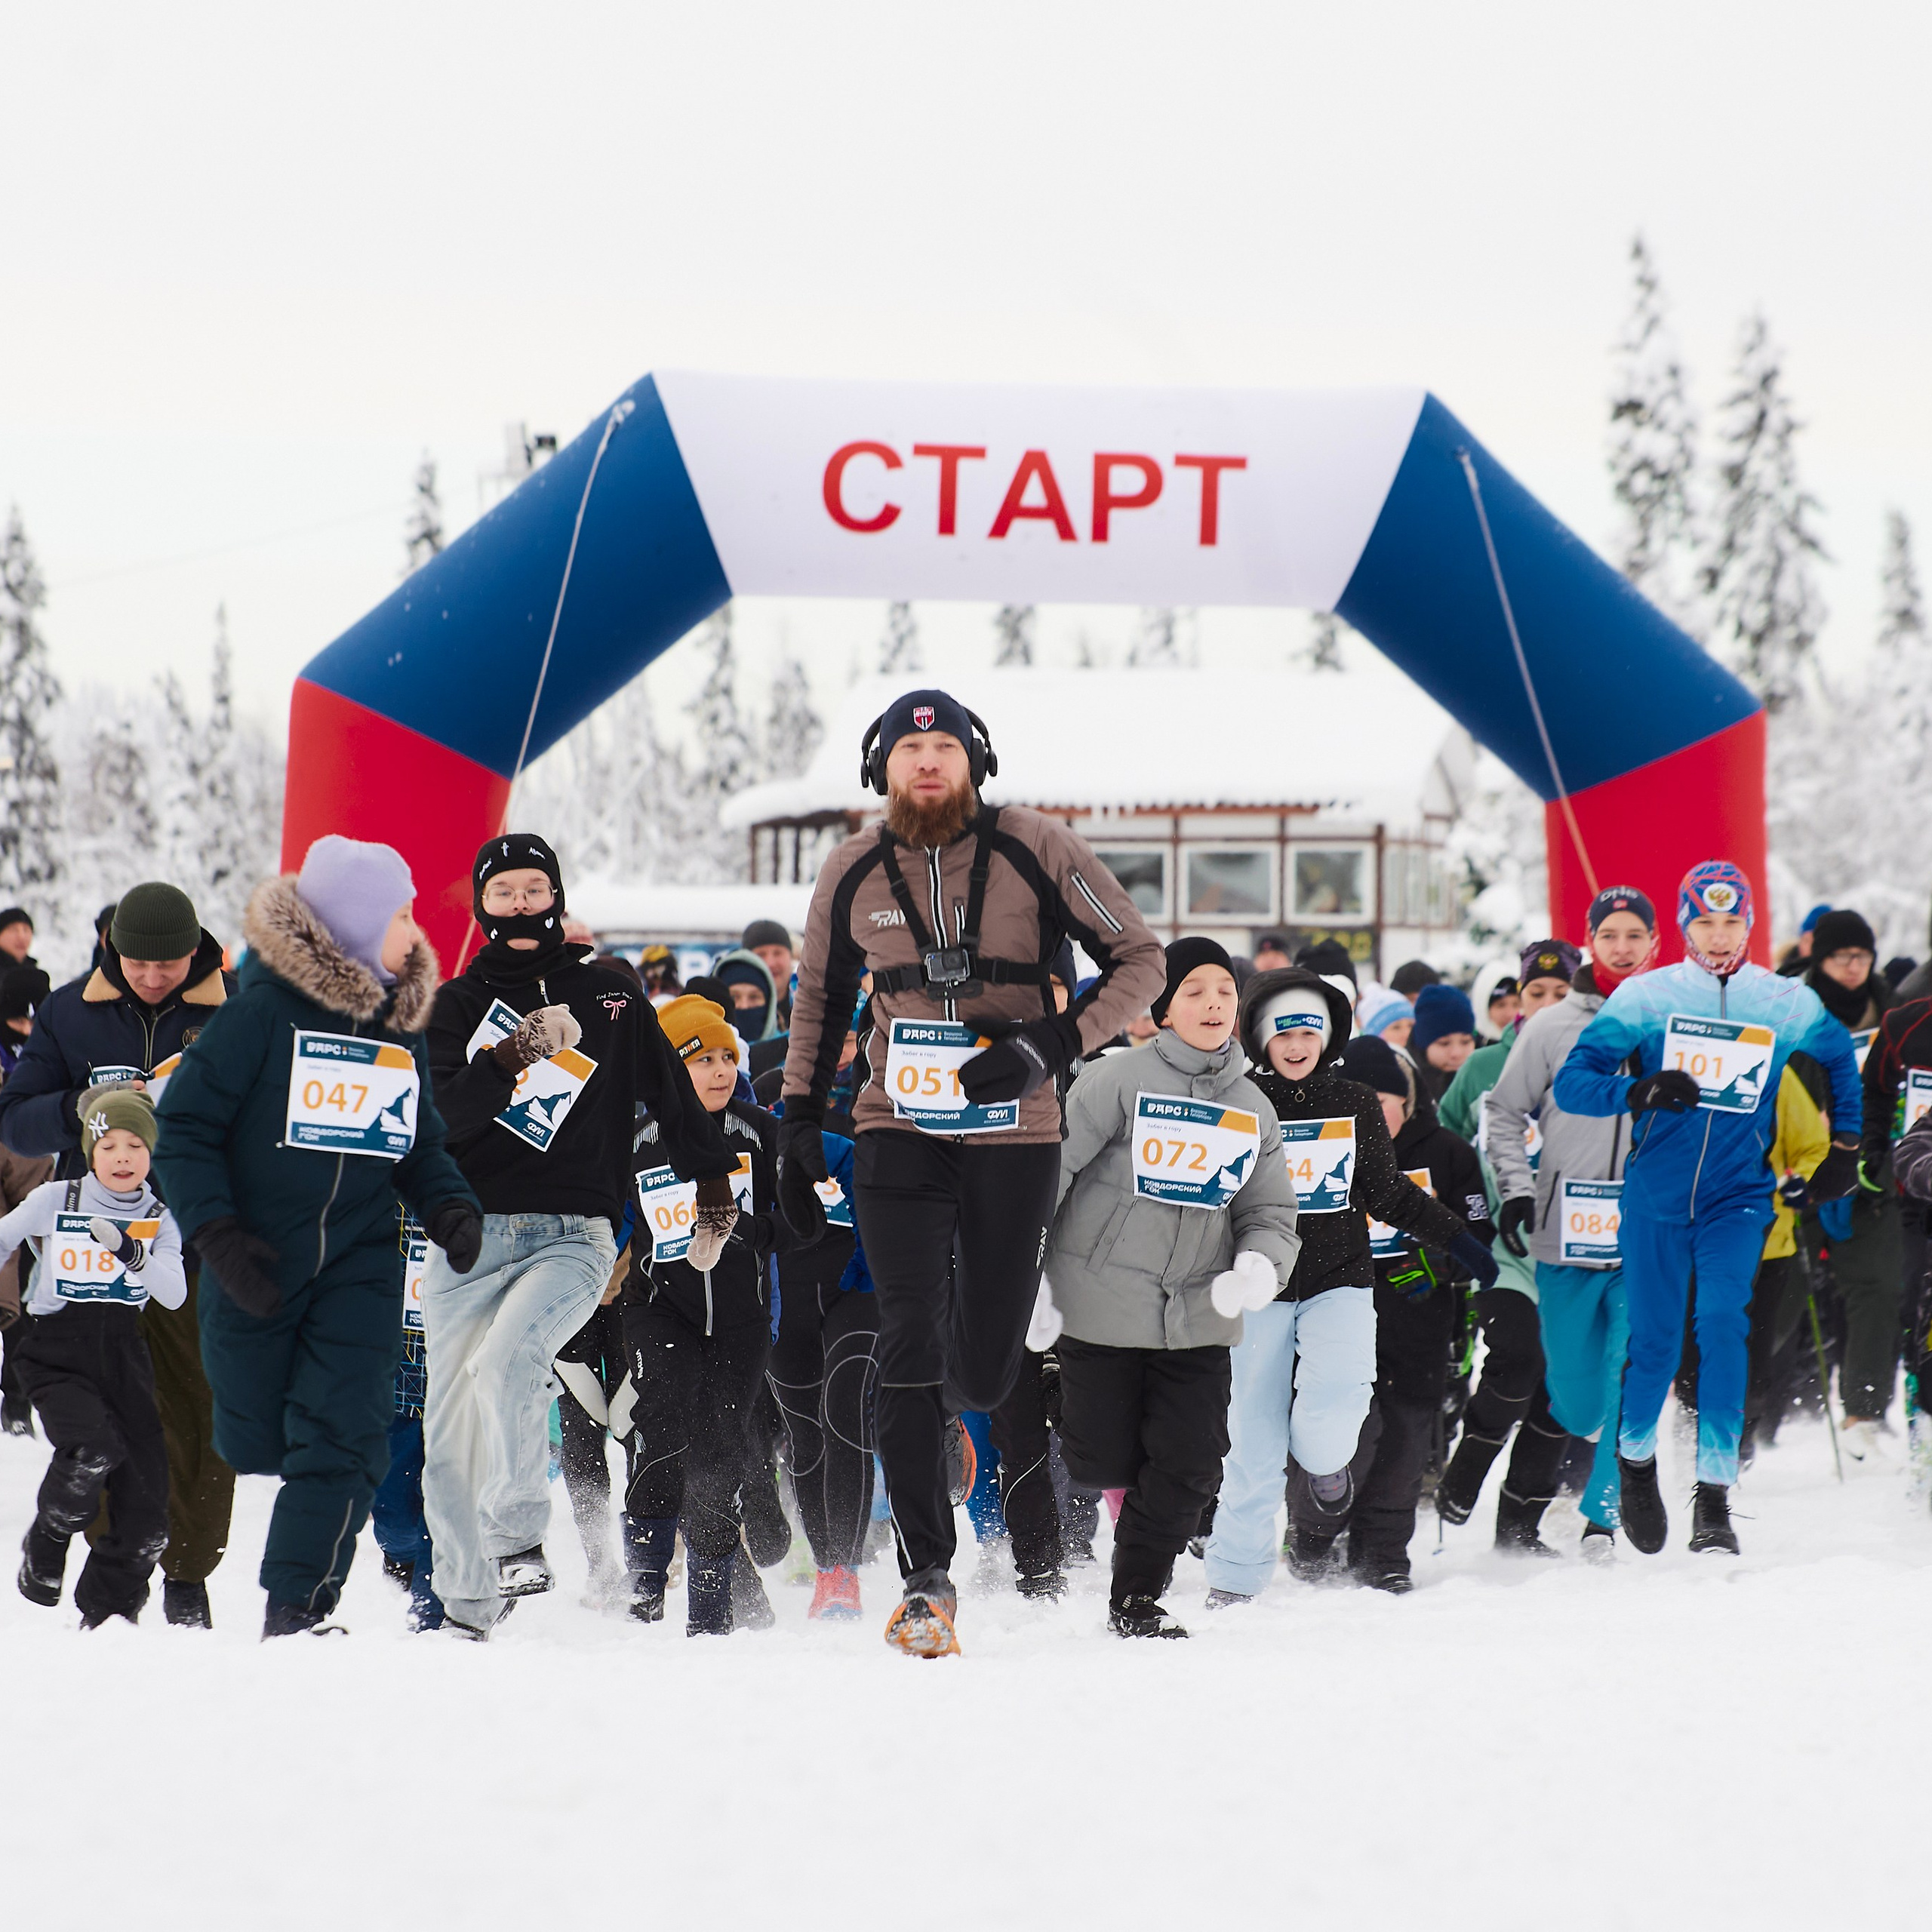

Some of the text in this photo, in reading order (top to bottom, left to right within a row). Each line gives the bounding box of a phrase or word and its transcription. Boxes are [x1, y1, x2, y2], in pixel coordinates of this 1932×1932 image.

[823, 440, 1247, 547] СТАРТ
[497, 1012, 518, 1031] ВАР
[678, 1038, 700, 1058] POWER
[1675, 1051, 1723, 1079] 101
[897, 1066, 960, 1097] 051
[303, 1080, 369, 1113] 047
[1143, 1137, 1208, 1171] 072
[1144, 1179, 1201, 1194] КОВДОРСКИЙ
[1571, 1213, 1619, 1235] 084
[663, 1238, 693, 1251] КОВДОРС
[60, 1249, 115, 1272] 018
